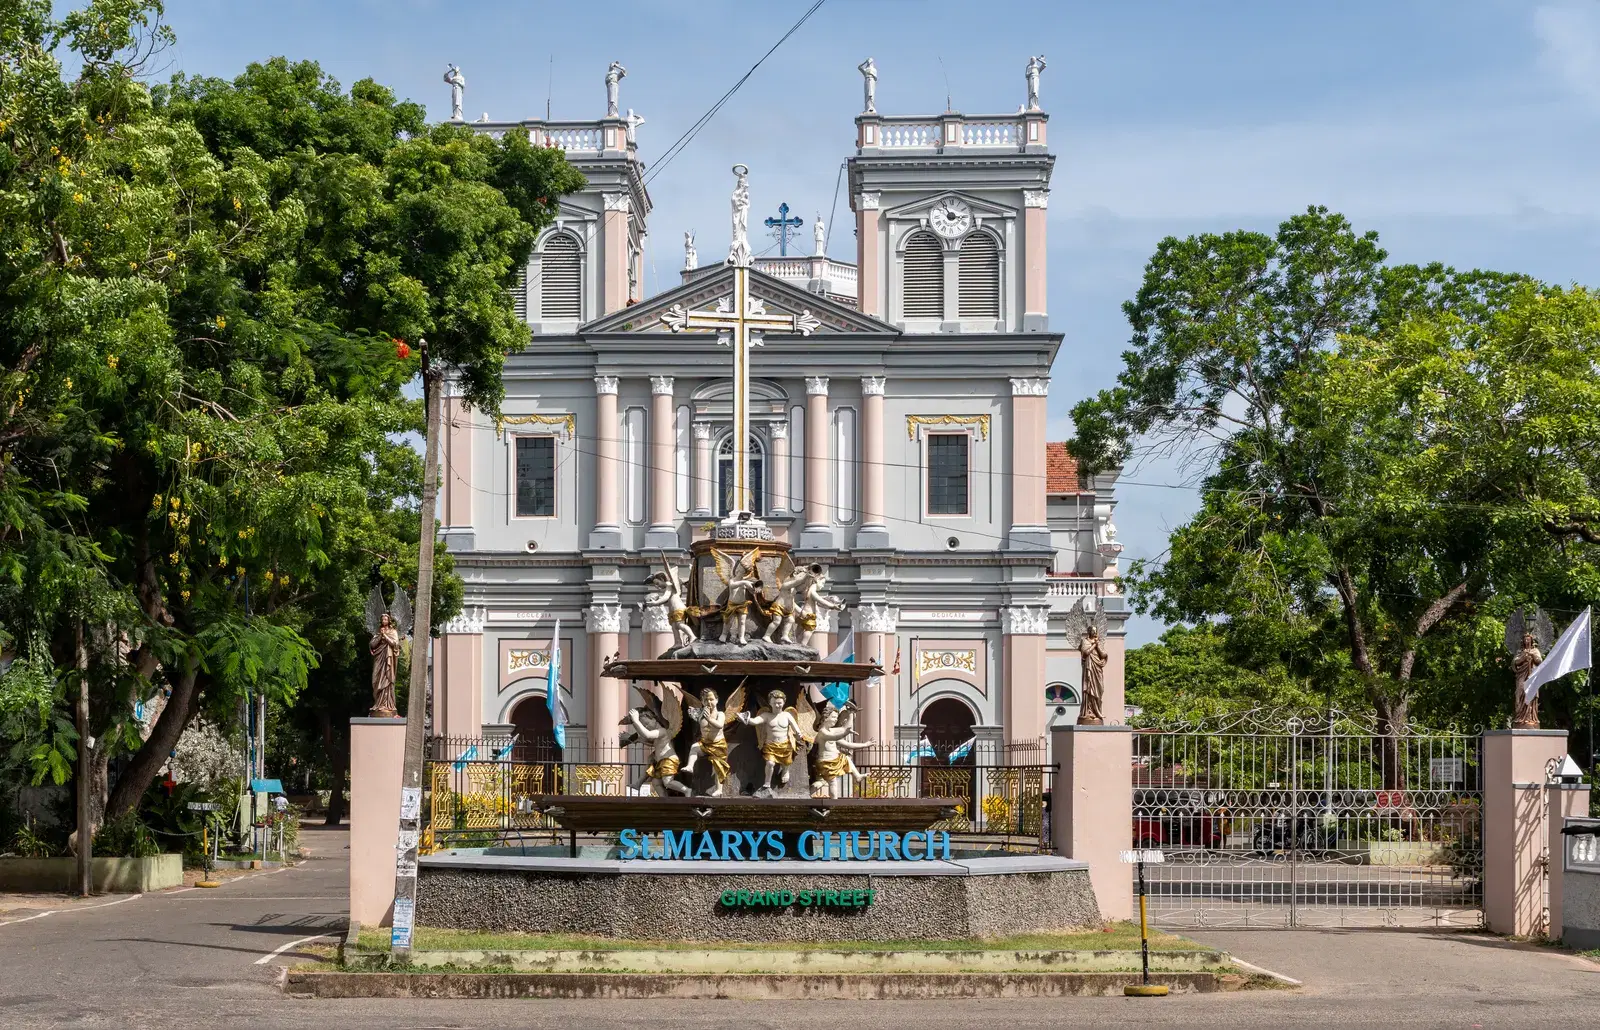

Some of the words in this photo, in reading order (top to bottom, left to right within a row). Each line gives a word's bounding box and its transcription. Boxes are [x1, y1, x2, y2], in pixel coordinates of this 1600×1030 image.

[797, 830, 951, 861] CHURCH
[720, 889, 794, 907] GRAND
[799, 889, 876, 907] STREET
